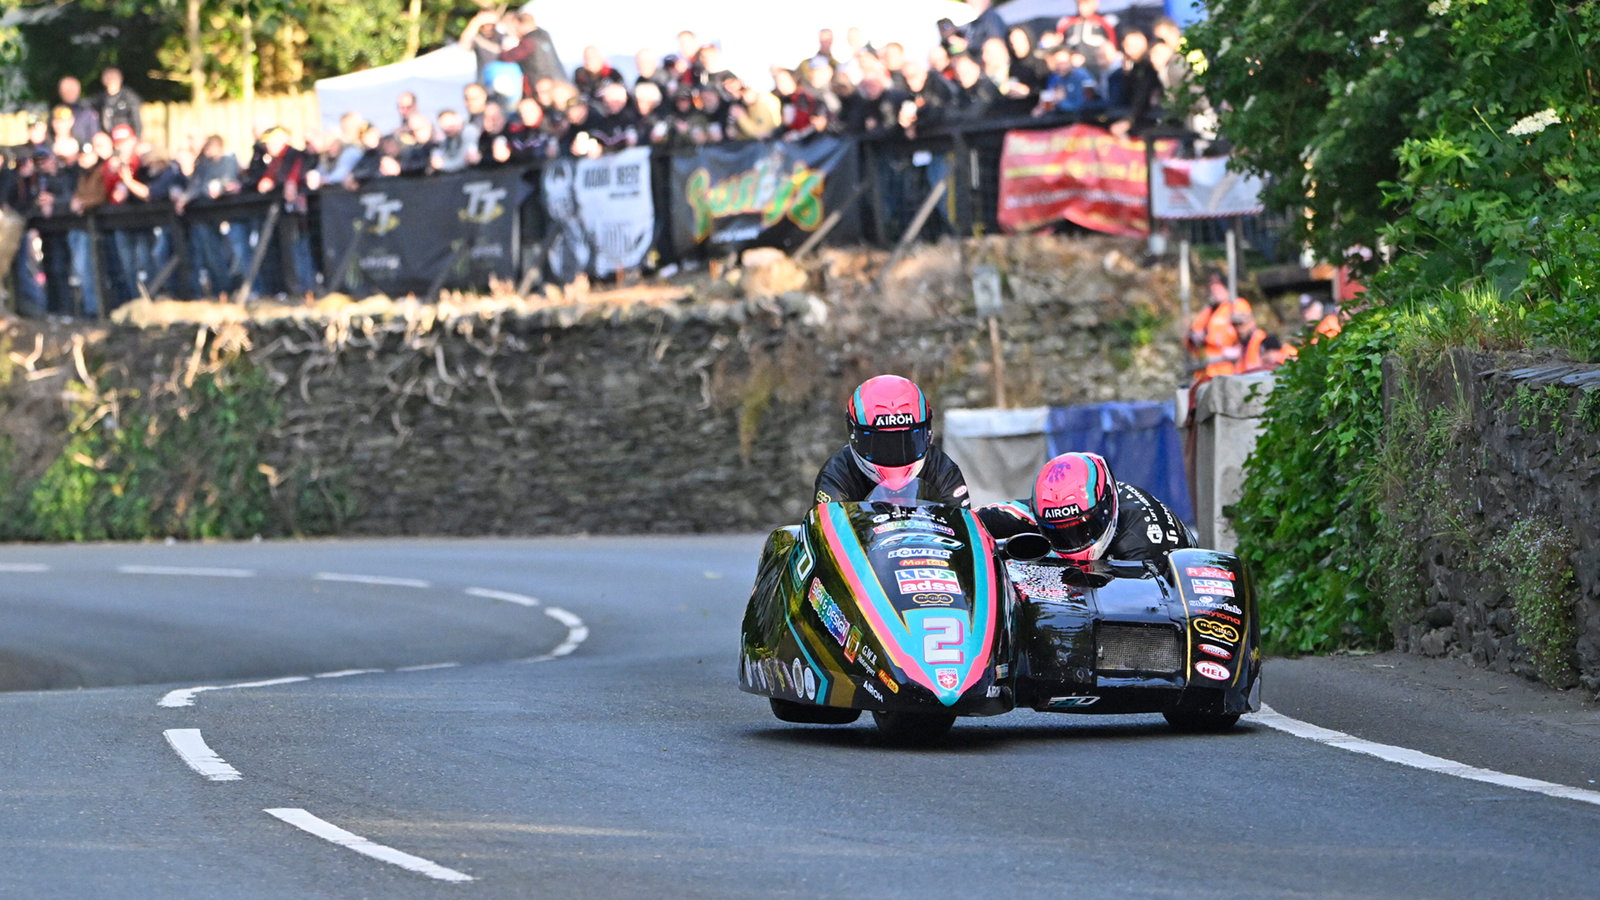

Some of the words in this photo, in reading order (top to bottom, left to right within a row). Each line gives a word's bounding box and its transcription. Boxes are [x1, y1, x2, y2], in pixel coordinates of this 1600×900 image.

[875, 414, 914, 426] AIROH
[1045, 505, 1080, 519] AIROH
[902, 580, 959, 592] adss
[811, 583, 825, 605] SIGN
[826, 605, 850, 637] DESIGN
[923, 617, 964, 665] 2
[1202, 667, 1224, 678] HEL
